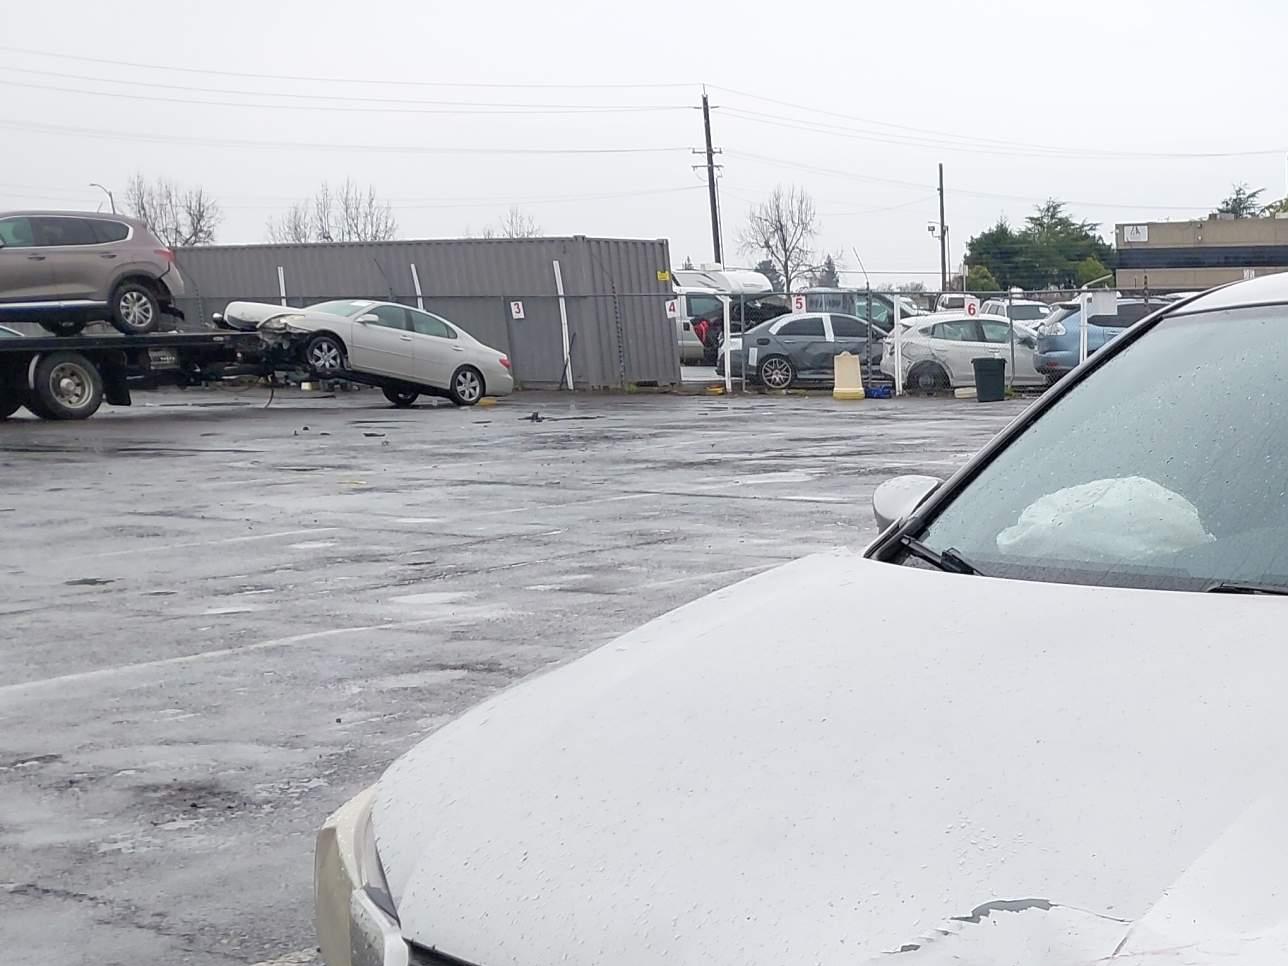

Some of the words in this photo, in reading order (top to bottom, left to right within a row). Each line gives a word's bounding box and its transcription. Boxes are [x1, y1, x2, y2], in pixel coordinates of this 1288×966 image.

[513, 302, 521, 315] 3
[668, 301, 676, 313] 4
[795, 297, 803, 310] 5
[967, 302, 977, 316] 6
